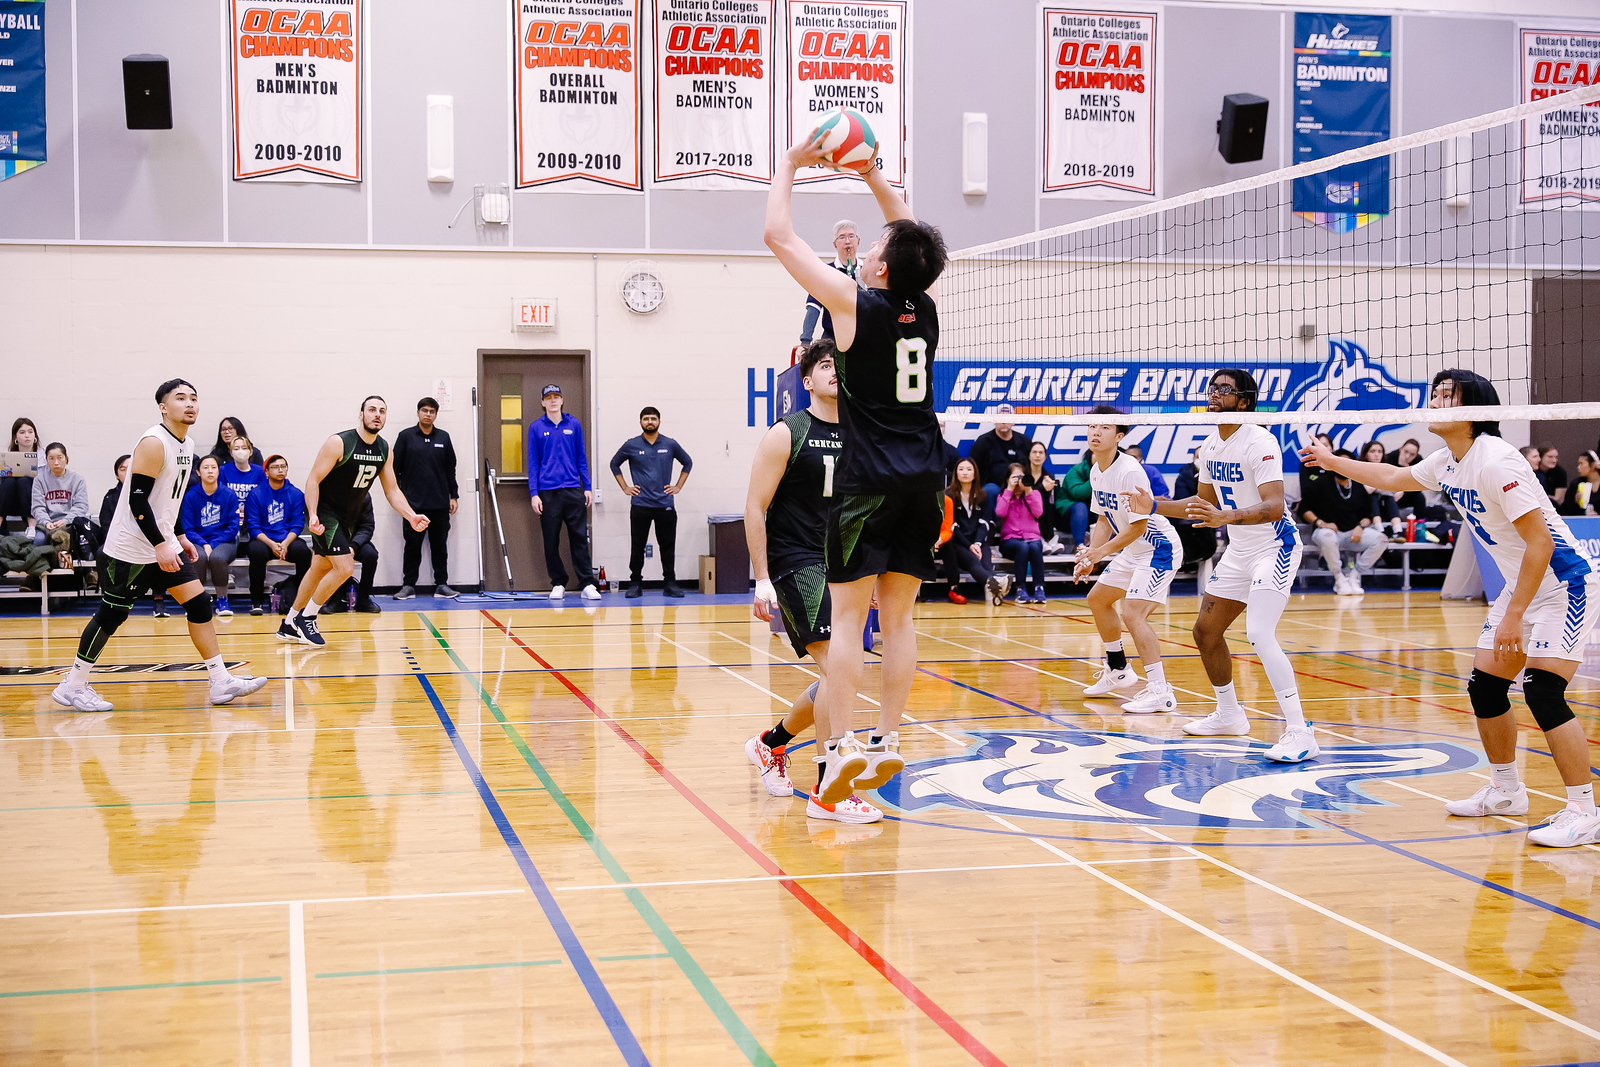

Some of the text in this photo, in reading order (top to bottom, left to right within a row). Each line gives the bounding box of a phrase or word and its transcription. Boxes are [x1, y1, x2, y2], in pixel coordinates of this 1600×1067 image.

[523, 5, 632, 17] Athletic Association
[671, 0, 759, 12] Ontario Colleges
[804, 5, 889, 18] Ontario Colleges
[241, 8, 353, 37] OCAA
[662, 11, 767, 24] Athletic Association
[795, 17, 897, 30] Athletic Association
[1061, 16, 1141, 30] Ontario Colleges
[525, 20, 631, 48] OCAA
[667, 23, 761, 56] OCAA
[1053, 28, 1149, 41] Athletic Association
[1306, 33, 1379, 51] HUSKIES
[1536, 36, 1568, 47] Ontario
[240, 35, 354, 62] CHAMPIONS
[800, 29, 893, 61] OCAA
[1528, 47, 1562, 57] Athletic
[525, 46, 632, 72] CHAMPIONS
[1057, 40, 1144, 71] OCAA
[275, 63, 316, 77] MEN'S
[665, 55, 763, 79] CHAMPIONS
[798, 61, 894, 84] CHAMPIONS
[1296, 64, 1388, 82] BADMINTON
[256, 79, 338, 95] BADMINTON
[549, 73, 605, 88] OVERALL
[692, 80, 737, 94] MEN'S
[1055, 71, 1145, 94] CHAMPIONS
[540, 89, 617, 105] BADMINTON
[814, 85, 879, 99] WOMEN'S
[676, 95, 752, 109] BADMINTON
[1080, 94, 1120, 108] MEN'S
[1065, 108, 1135, 123] BADMINTON
[1544, 110, 1598, 123] WOMEN'S
[254, 143, 342, 161] 2009-2010
[675, 152, 753, 166] 2017-2018
[537, 153, 622, 170] 2009-2010
[1063, 163, 1135, 178] 2018-2019
[521, 305, 550, 323] EXIT
[896, 337, 927, 403] 8
[950, 367, 1292, 402] GEORGE BRON
[353, 464, 377, 488] 12
[1220, 486, 1238, 510] 5
